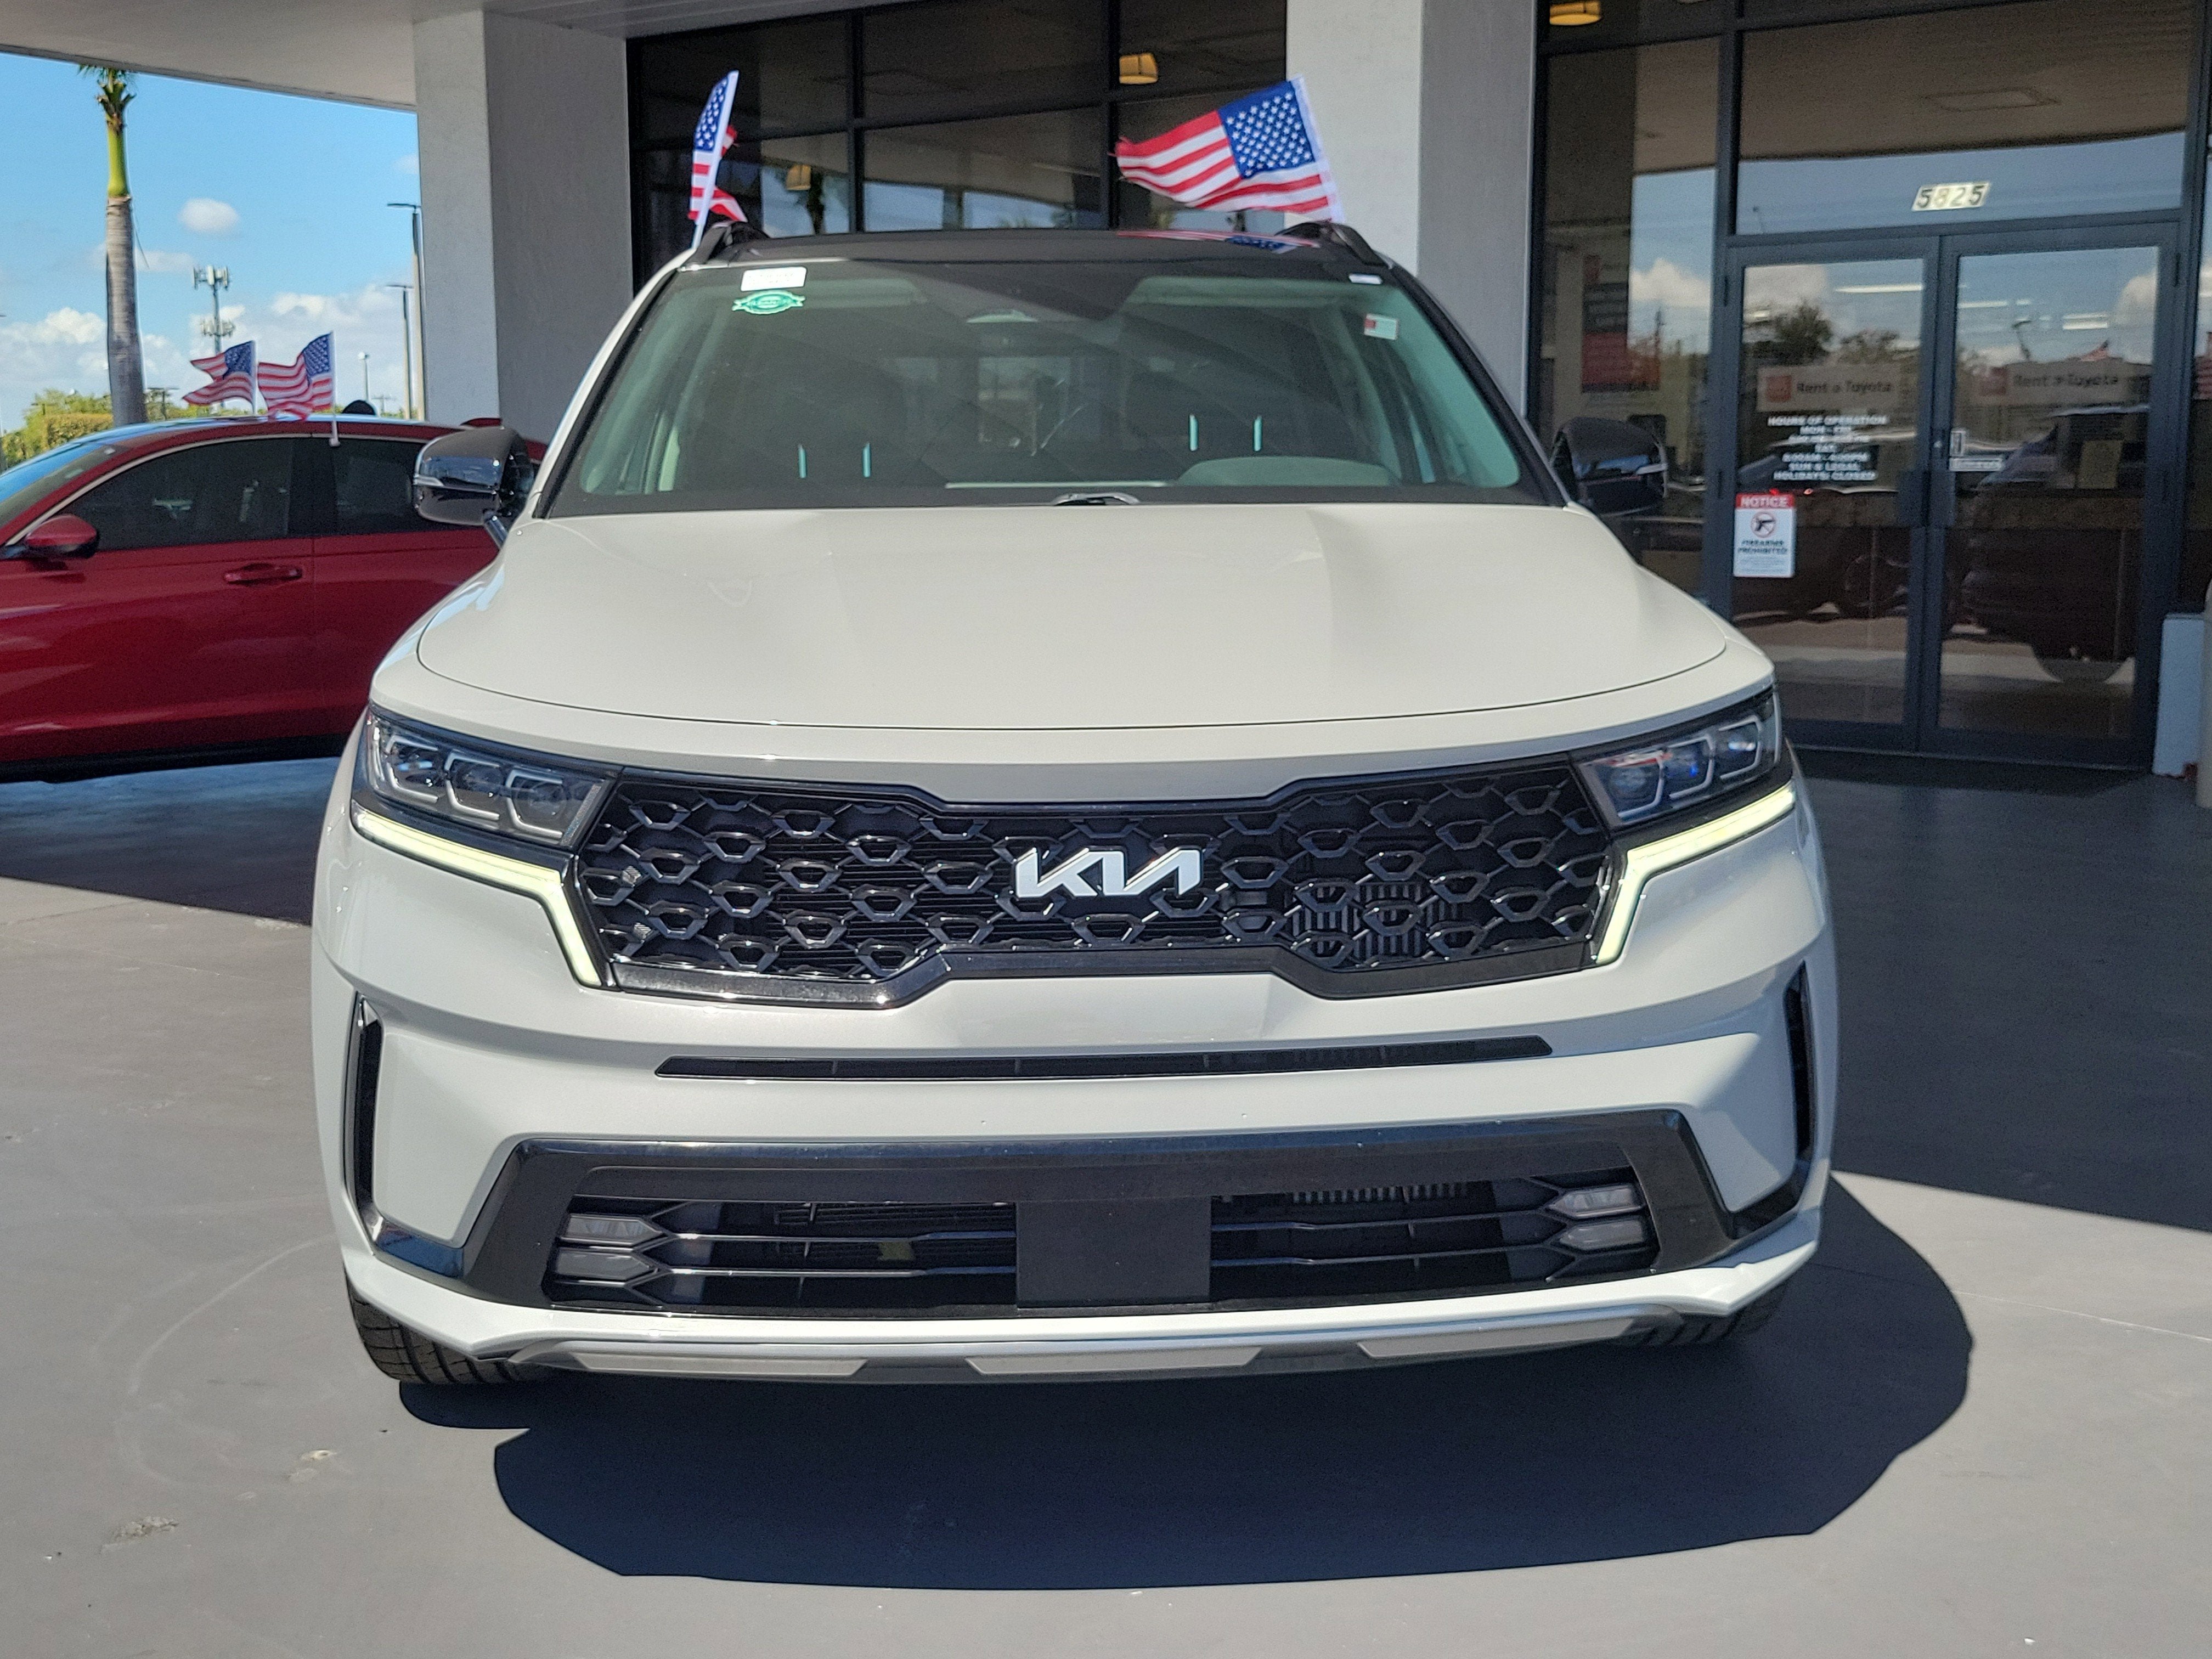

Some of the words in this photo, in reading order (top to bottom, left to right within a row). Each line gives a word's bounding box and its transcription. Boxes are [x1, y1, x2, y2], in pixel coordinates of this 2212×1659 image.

[1917, 184, 1984, 208] 5825
[1768, 415, 1806, 426] HOURS
[1807, 415, 1823, 425] OF
[1824, 415, 1888, 425] OPERATION
[1831, 470, 1876, 481] CLOSED
[1740, 495, 1788, 508] NOTICE
[1015, 846, 1201, 899] KIA
